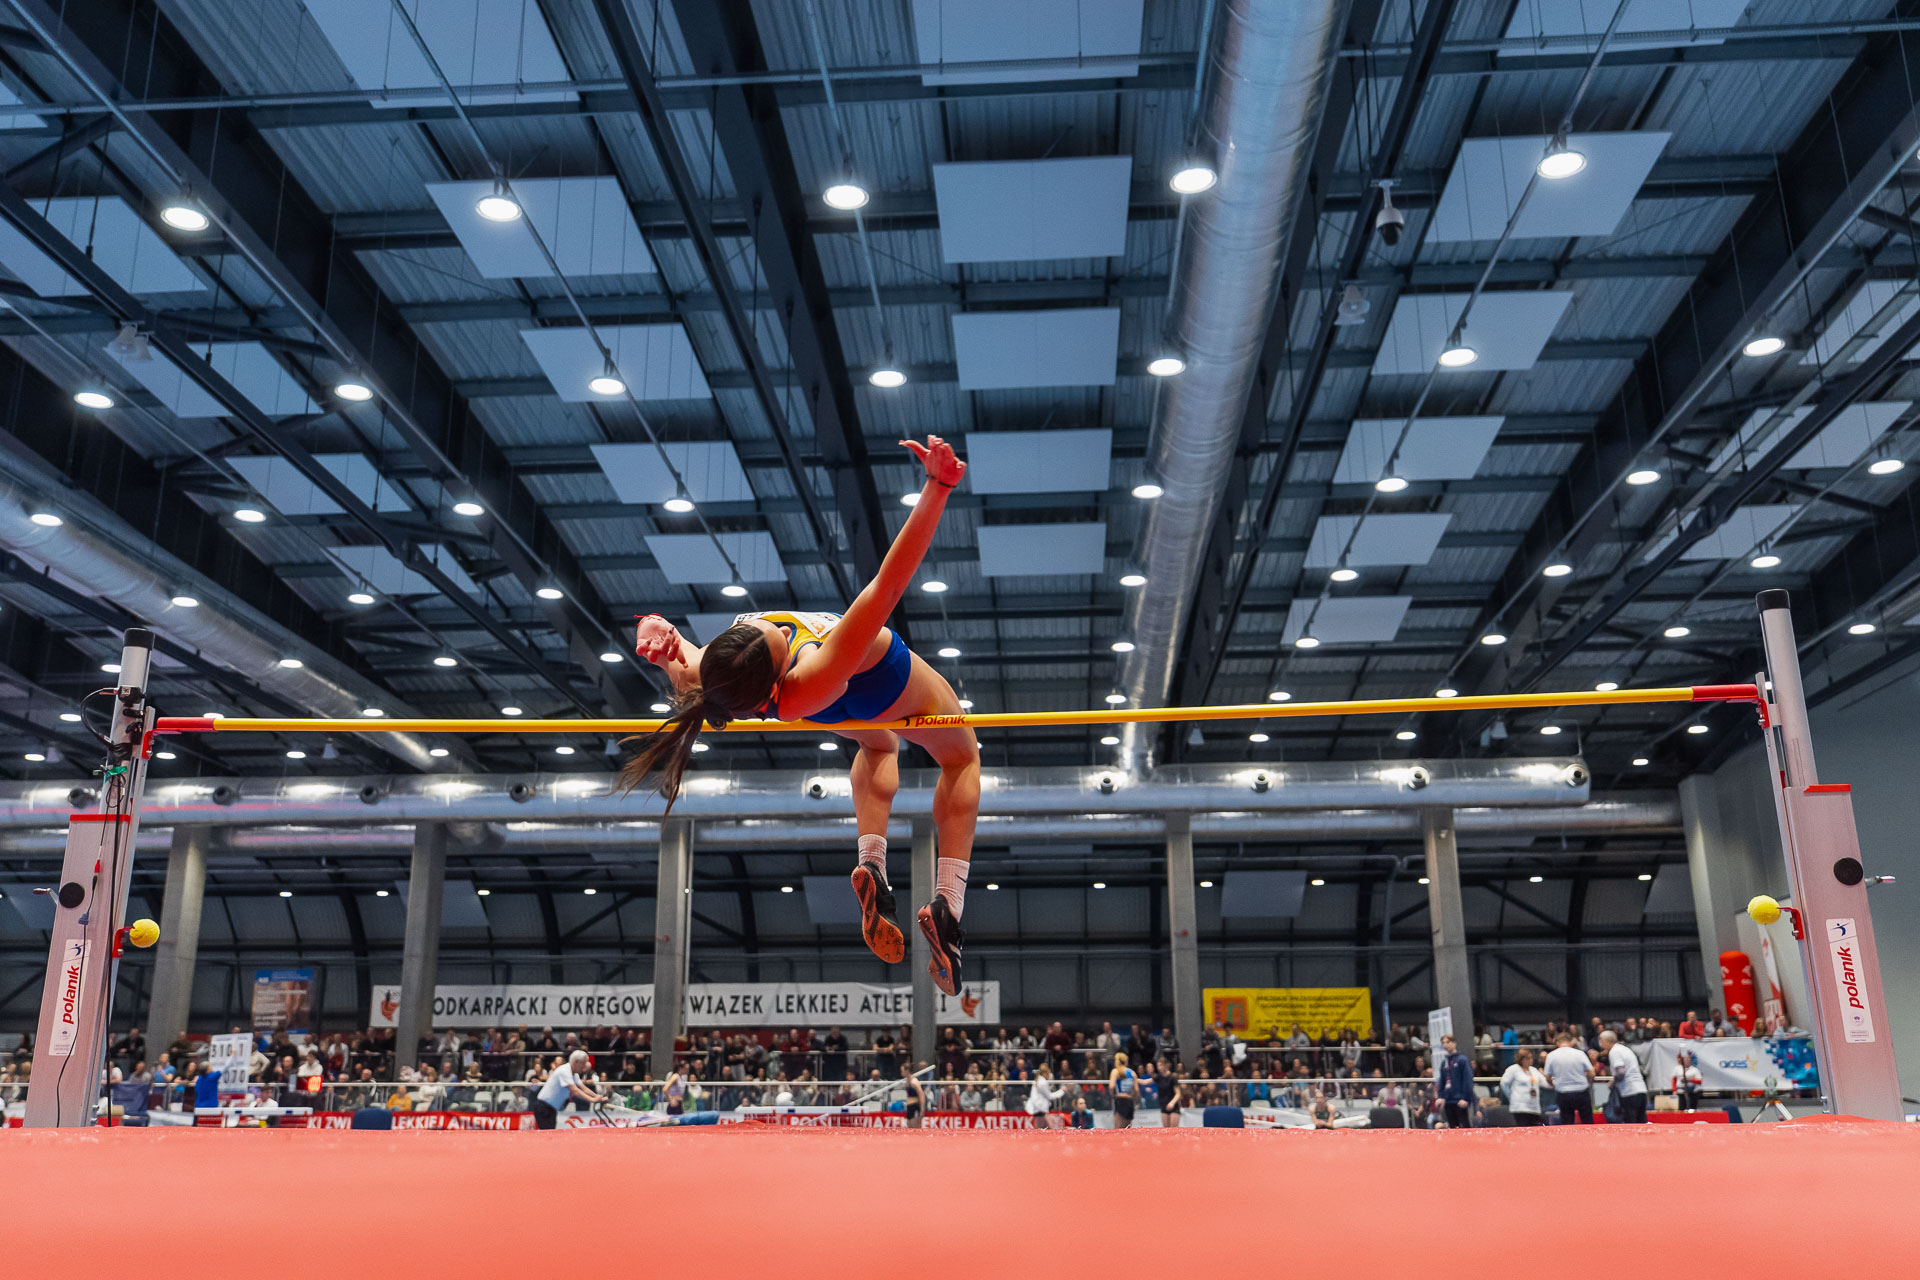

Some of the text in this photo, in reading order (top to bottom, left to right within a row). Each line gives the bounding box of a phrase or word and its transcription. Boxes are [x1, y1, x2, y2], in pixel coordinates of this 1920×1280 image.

[915, 715, 966, 727] polanik
[1837, 946, 1864, 1009] polanik
[62, 965, 80, 1025] polanik
[433, 993, 947, 1018] ODKARPACKI OKRĘGOW WIĄZEK LEKKIEJ ATLETI
[447, 1115, 511, 1130] ATLETYKI
[921, 1116, 970, 1129] EKKIEJ
[974, 1116, 1034, 1129] ATLETYK
